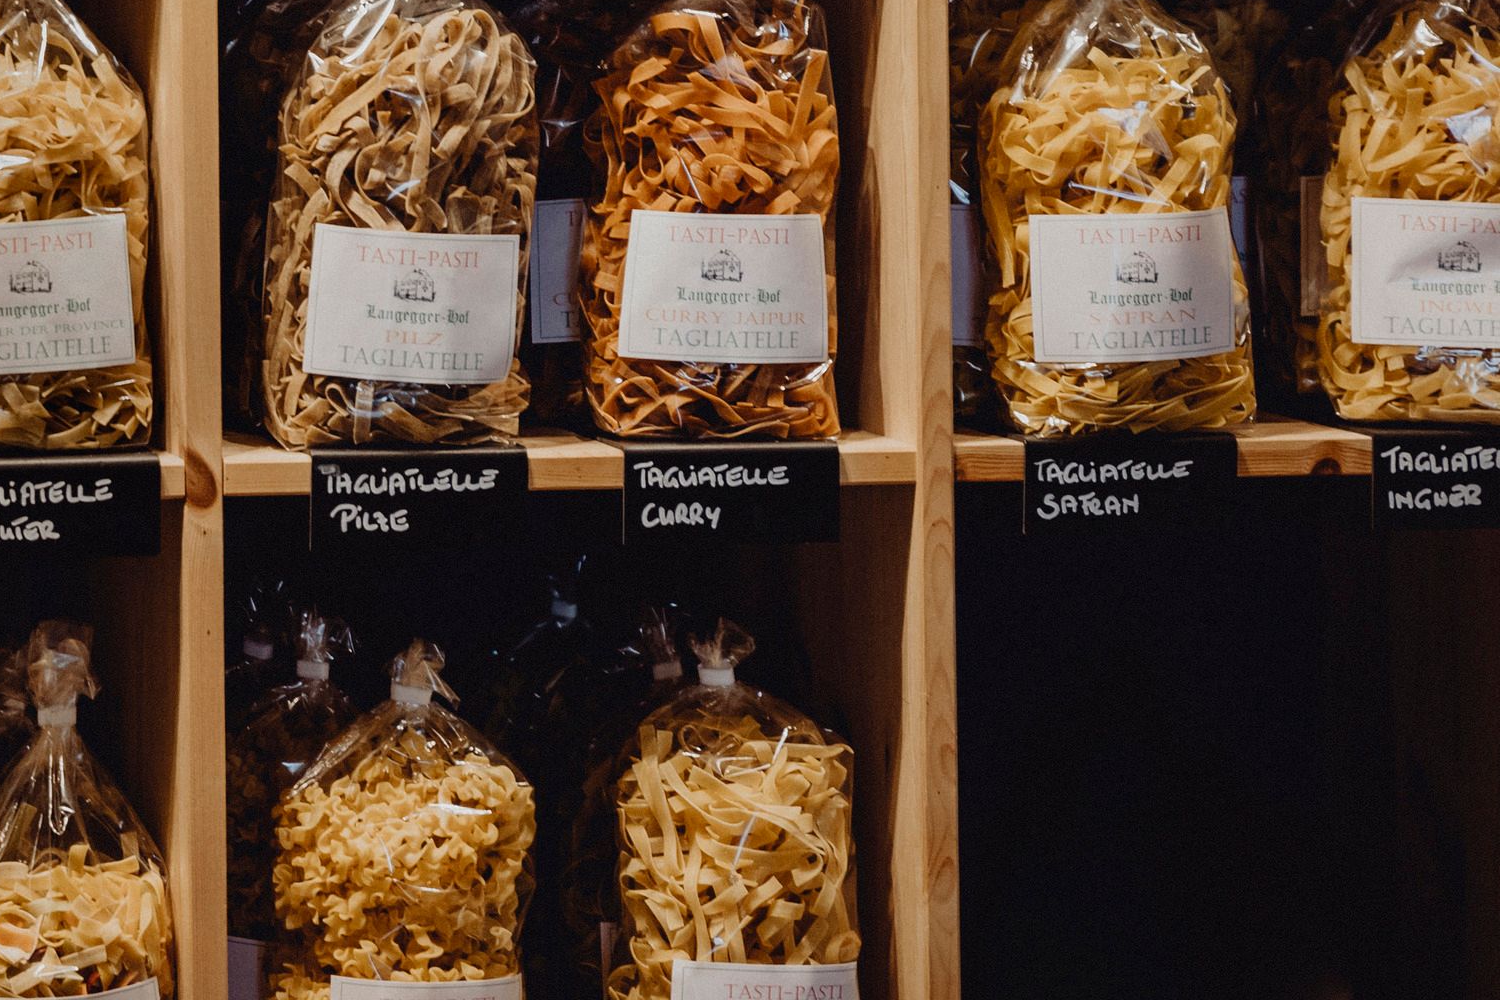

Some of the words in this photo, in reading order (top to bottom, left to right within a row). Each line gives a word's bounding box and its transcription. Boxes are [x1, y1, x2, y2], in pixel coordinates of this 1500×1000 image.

[668, 225, 790, 244] TASTI-PASTI
[1076, 225, 1201, 245] TASTI-PASTI
[356, 245, 479, 268] TASTI-PASTI
[644, 309, 726, 324] CURRY
[733, 311, 806, 326] JAIPUR
[1089, 308, 1197, 326] SAFRAN
[20, 325, 49, 336] DER
[54, 319, 126, 334] PROVENCE
[385, 330, 443, 345] PILZ
[652, 328, 801, 349] TAGLIATELLE
[1068, 326, 1212, 350] TAGLIATELLE
[338, 345, 484, 371] TAGLIATELLE
[641, 502, 721, 529] CURRY
